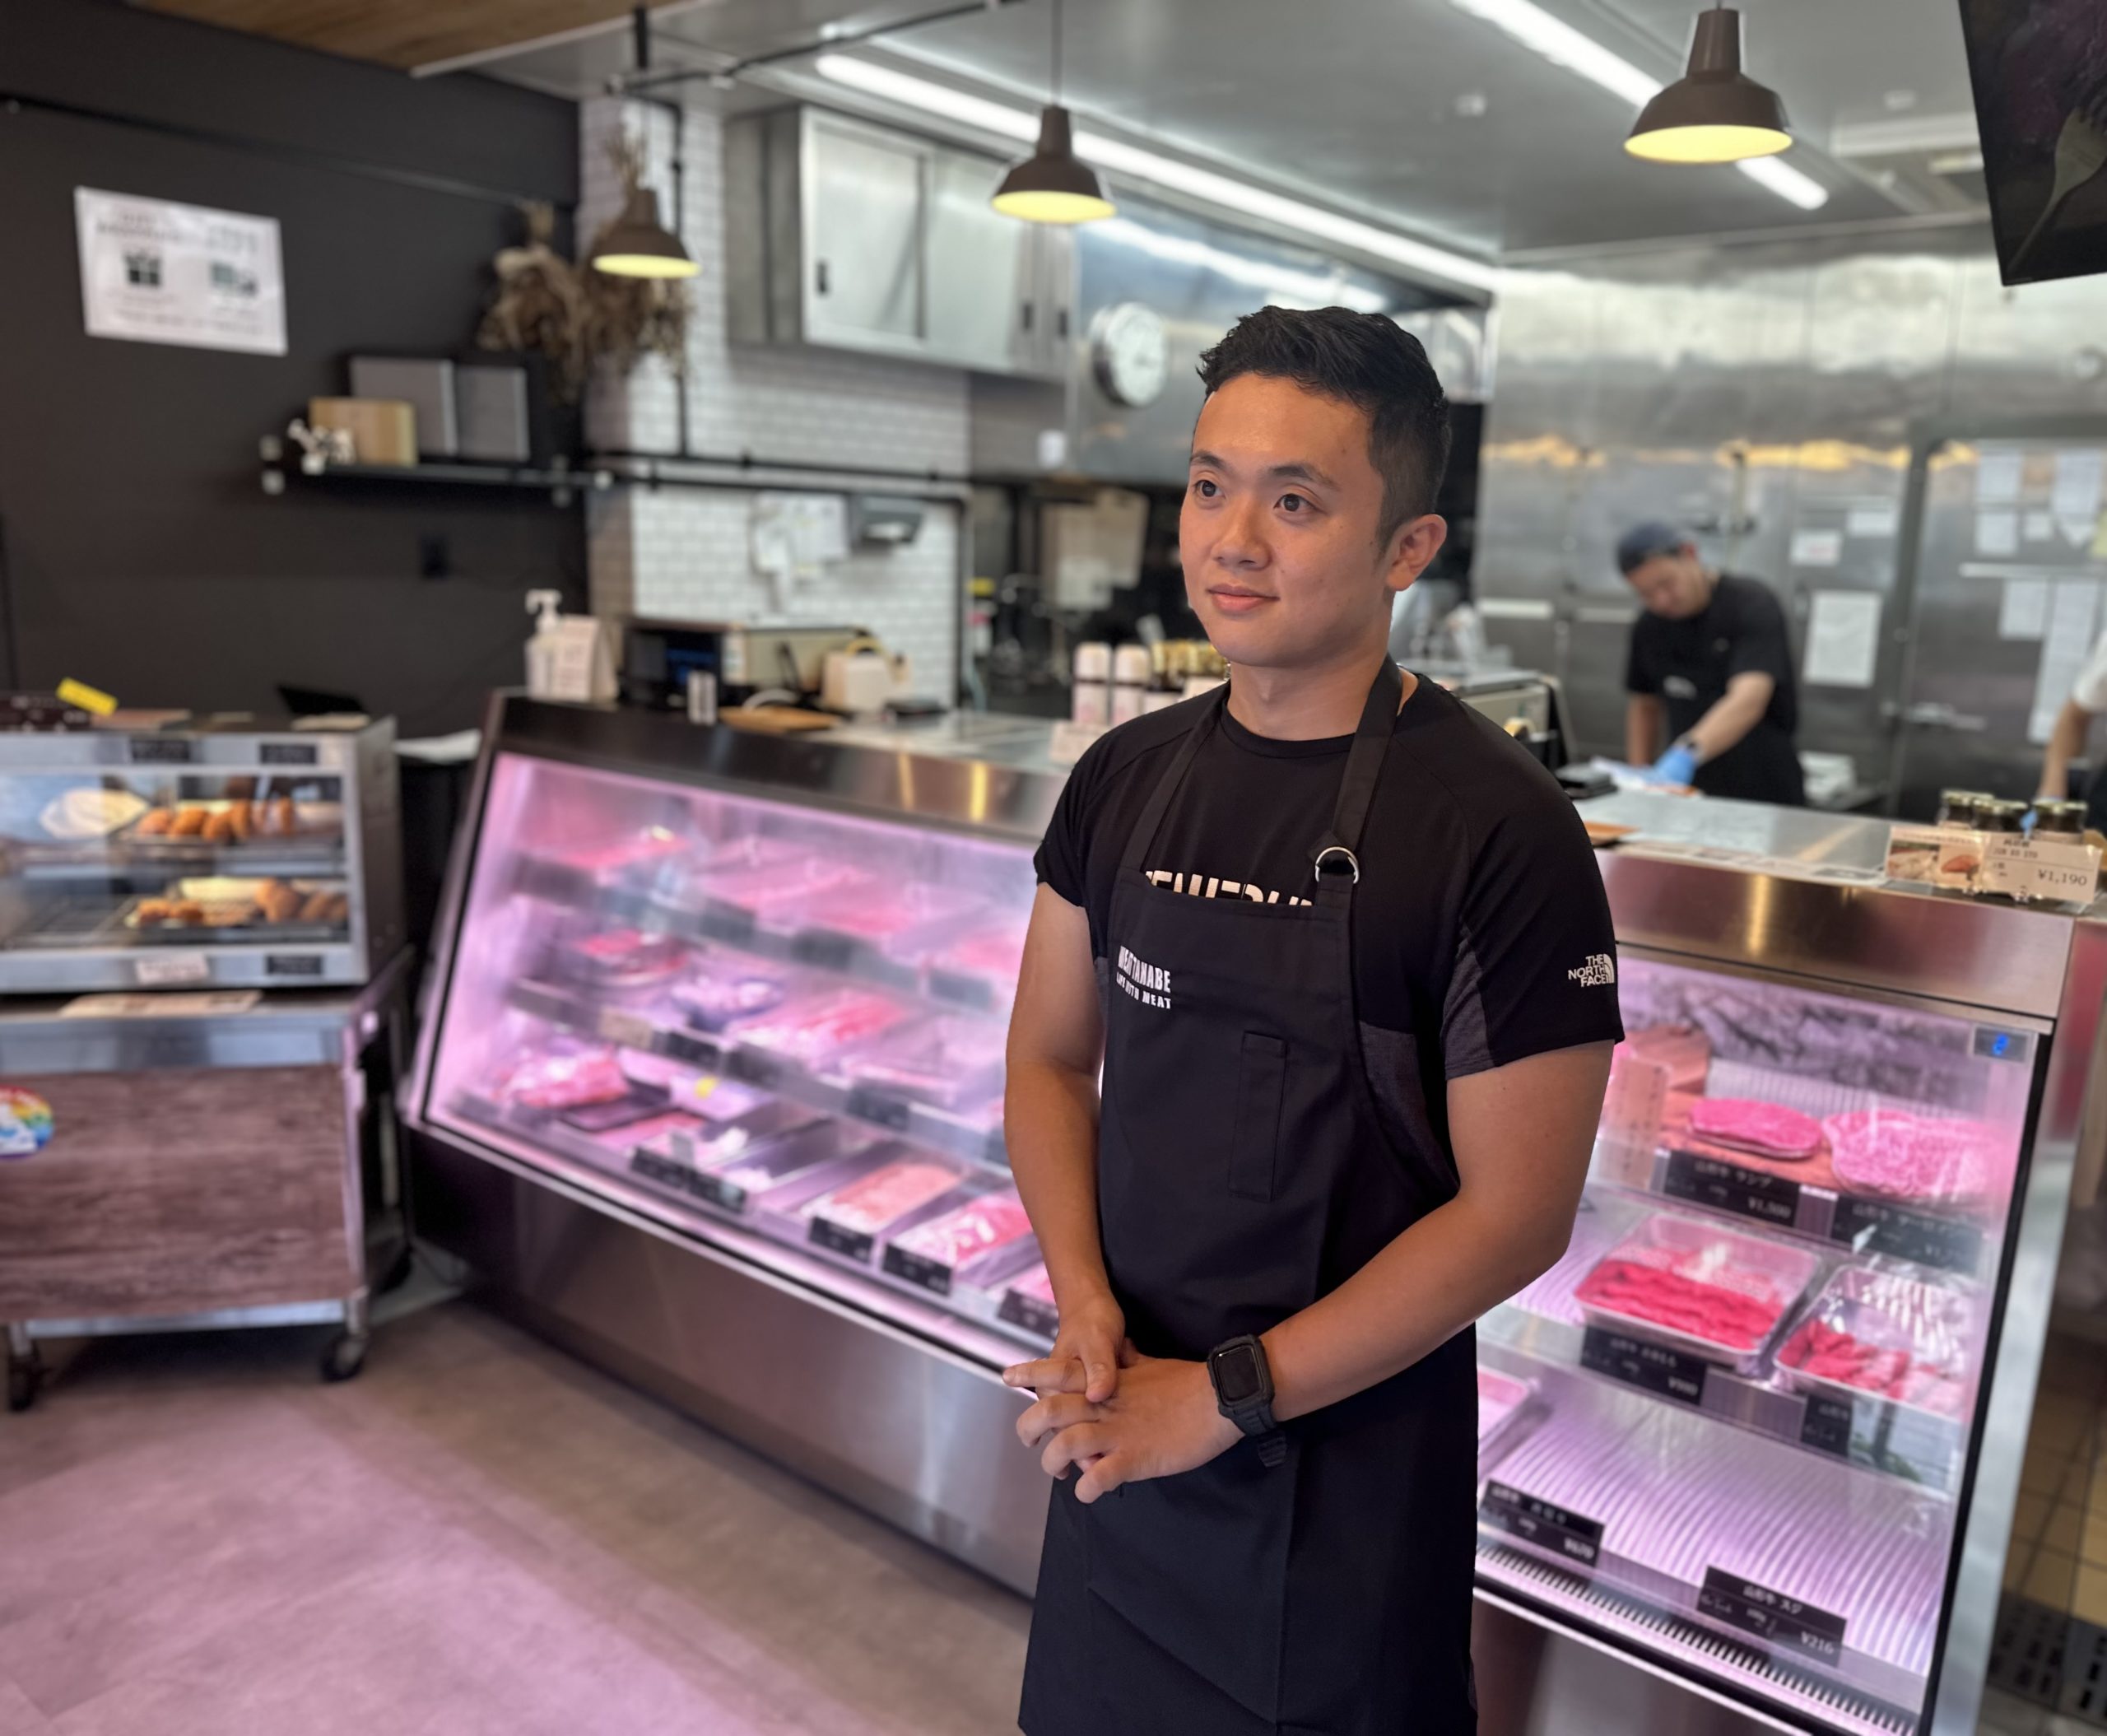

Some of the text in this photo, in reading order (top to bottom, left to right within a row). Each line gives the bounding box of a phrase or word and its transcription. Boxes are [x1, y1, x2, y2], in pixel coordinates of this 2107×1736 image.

[2038, 869, 2087, 887] ¥1,190
[1585, 954, 1604, 966] THE
[1567, 964, 1605, 980] NORTH
[1580, 974, 1607, 988] FACE
[1142, 990, 1171, 1010] MEAT
